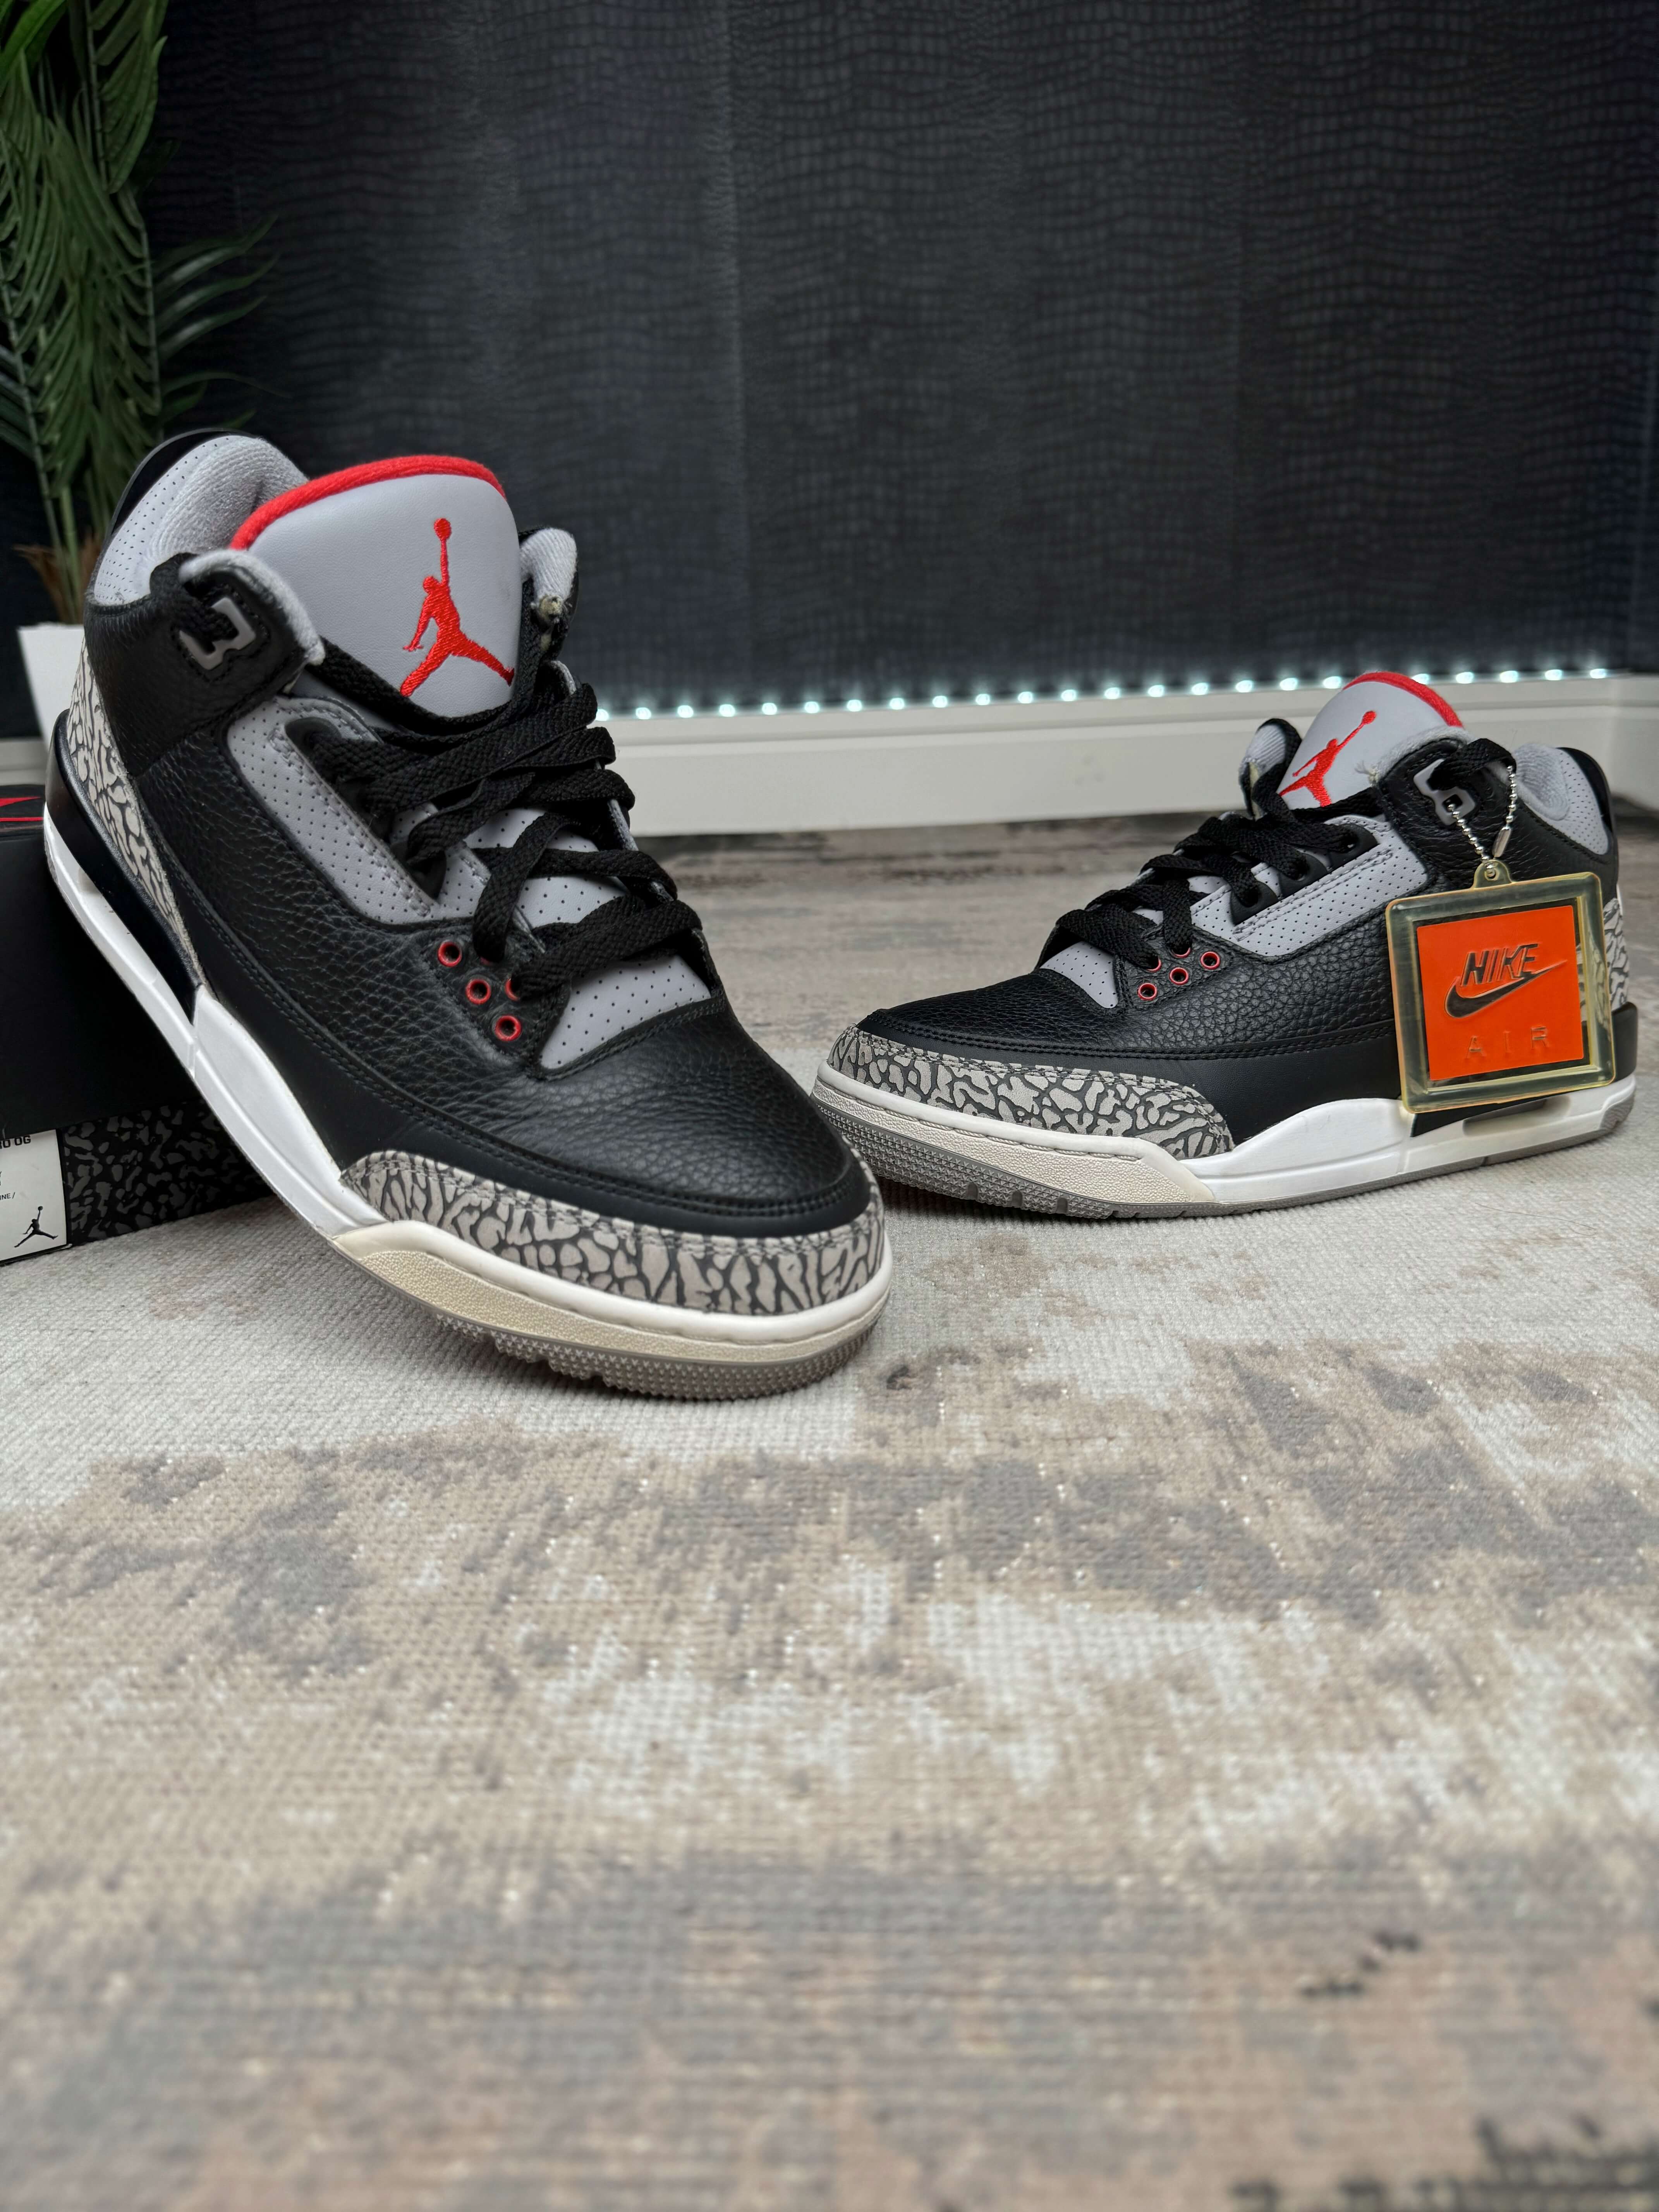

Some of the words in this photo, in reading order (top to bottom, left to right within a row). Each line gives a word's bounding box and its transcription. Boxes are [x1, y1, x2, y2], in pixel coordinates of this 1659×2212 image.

[1460, 943, 1540, 987] NIKE
[1465, 1026, 1550, 1059] AIR
[0, 1140, 10, 1149] O
[14, 1135, 31, 1146] OG
